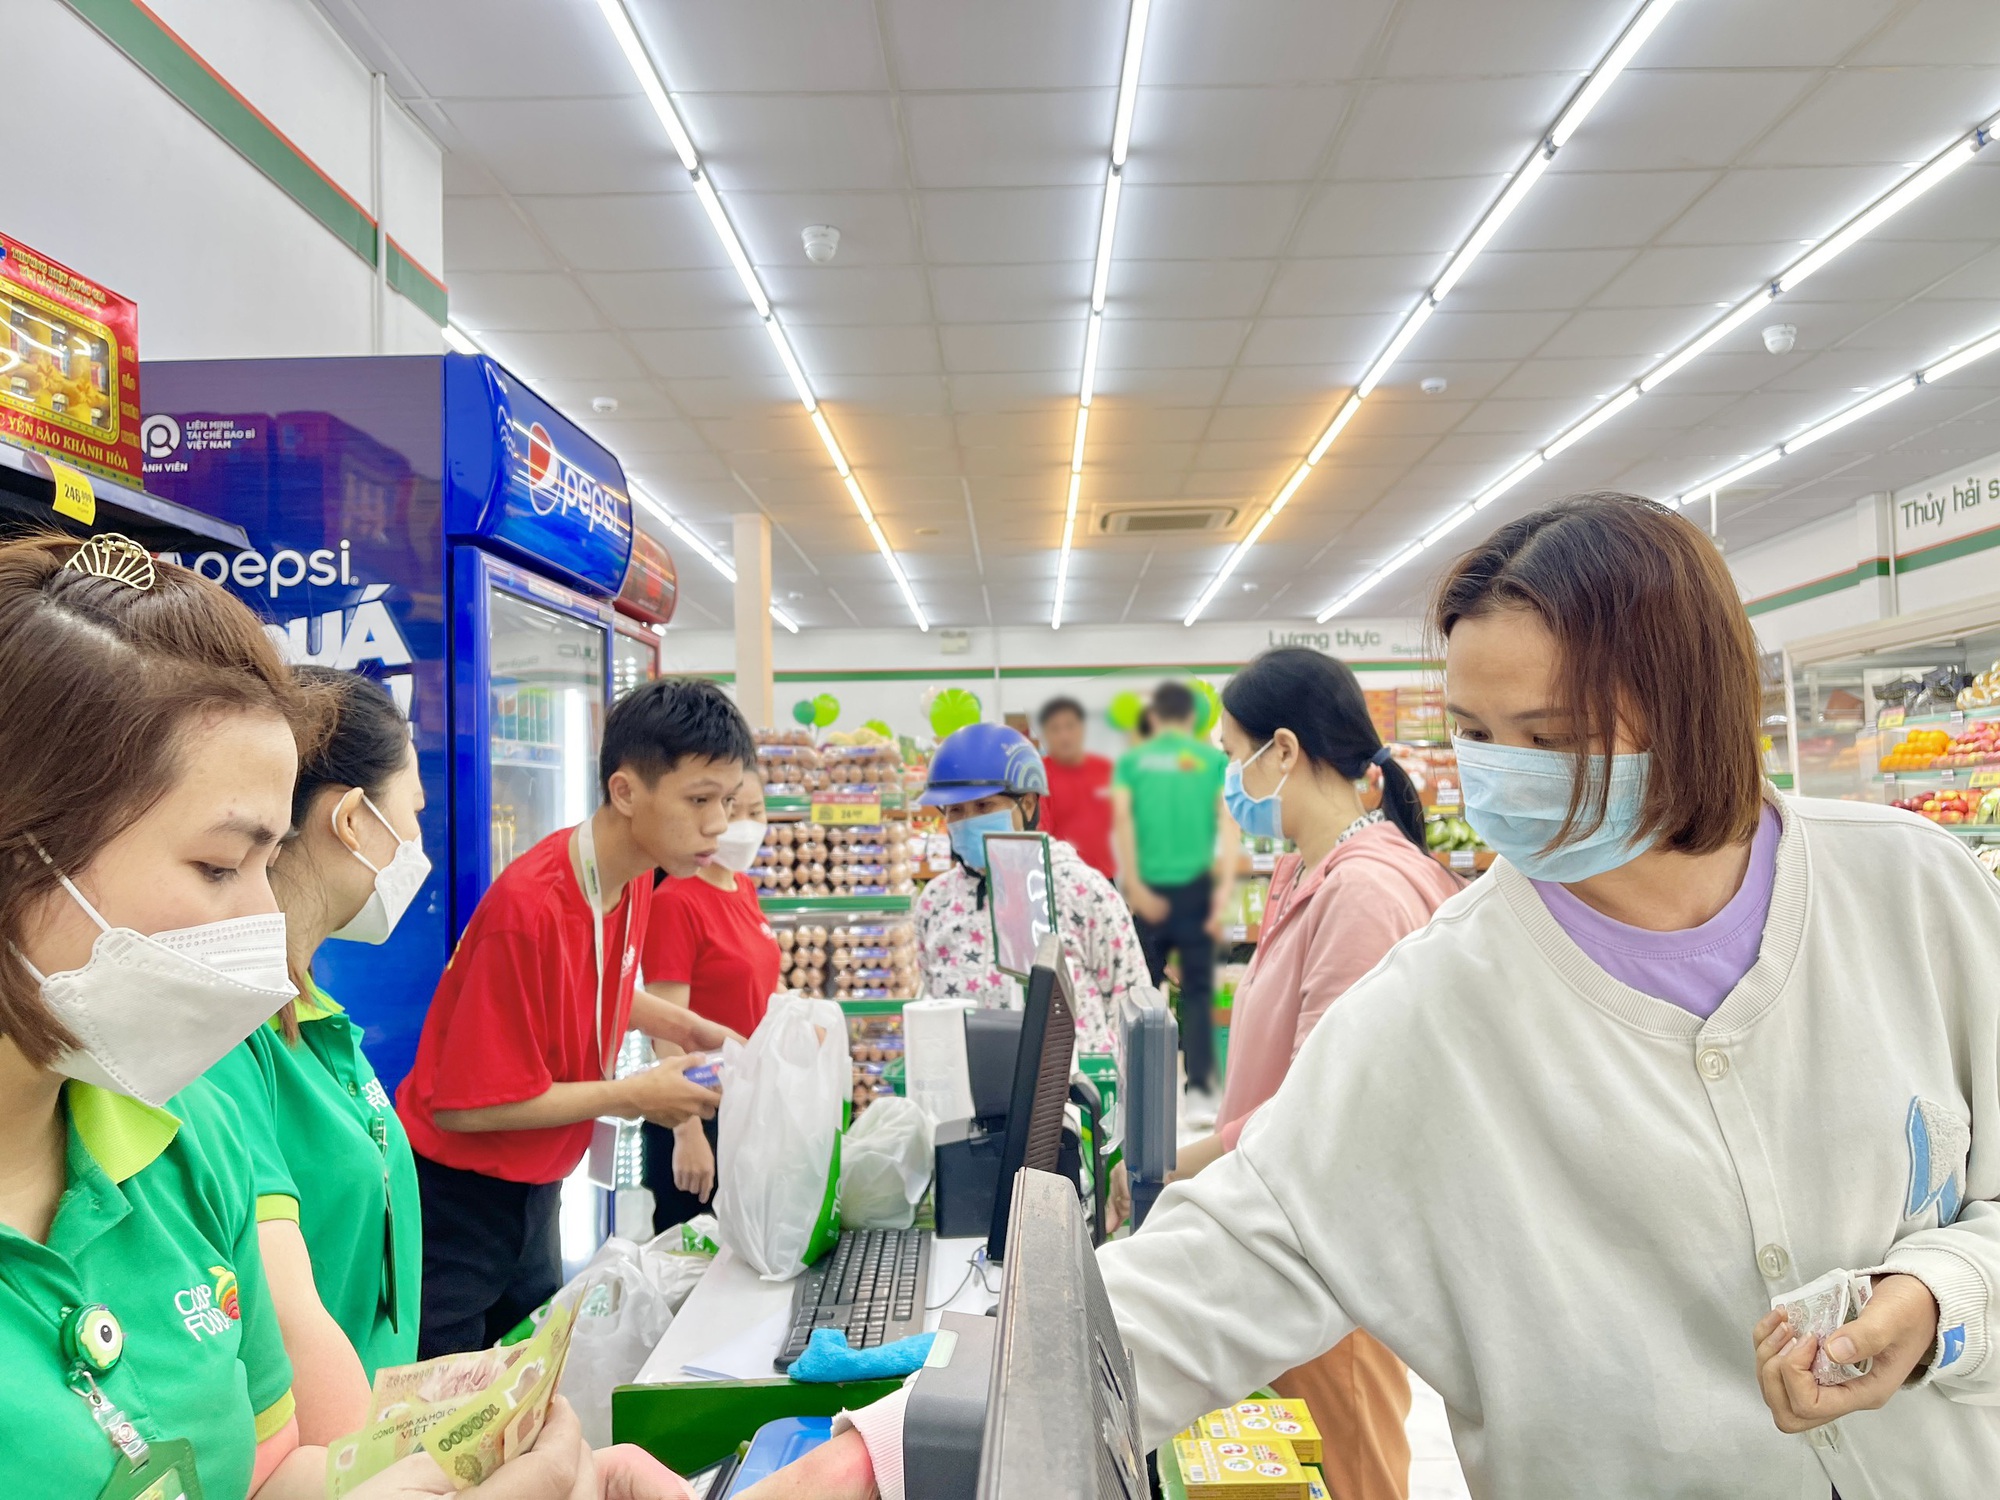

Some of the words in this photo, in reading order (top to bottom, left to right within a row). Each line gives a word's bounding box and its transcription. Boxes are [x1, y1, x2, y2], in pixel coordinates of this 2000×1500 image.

[186, 420, 208, 431] LIÊN
[209, 420, 234, 430] MINH
[203, 428, 222, 440] CHẾ
[224, 430, 244, 439] BAO
[245, 428, 256, 439] BÌ
[8, 414, 34, 436] YẾN
[36, 425, 60, 446] SÀO
[63, 436, 104, 461] KHÁNH
[106, 451, 129, 471] HÒA
[187, 439, 208, 451] VIỆT
[209, 440, 232, 449] NAM
[142, 461, 163, 473] ÀNH
[164, 461, 188, 472] VIÊN
[64, 483, 81, 504] 246
[562, 467, 620, 533] pepsi
[1900, 491, 1946, 530] Thủy
[1952, 477, 1981, 514] hải
[1269, 629, 1330, 650] Lương
[1336, 628, 1381, 650] thực
[174, 1284, 212, 1316] COOP
[184, 1308, 230, 1342] FOOD
[401, 1422, 428, 1440] VIỆT
